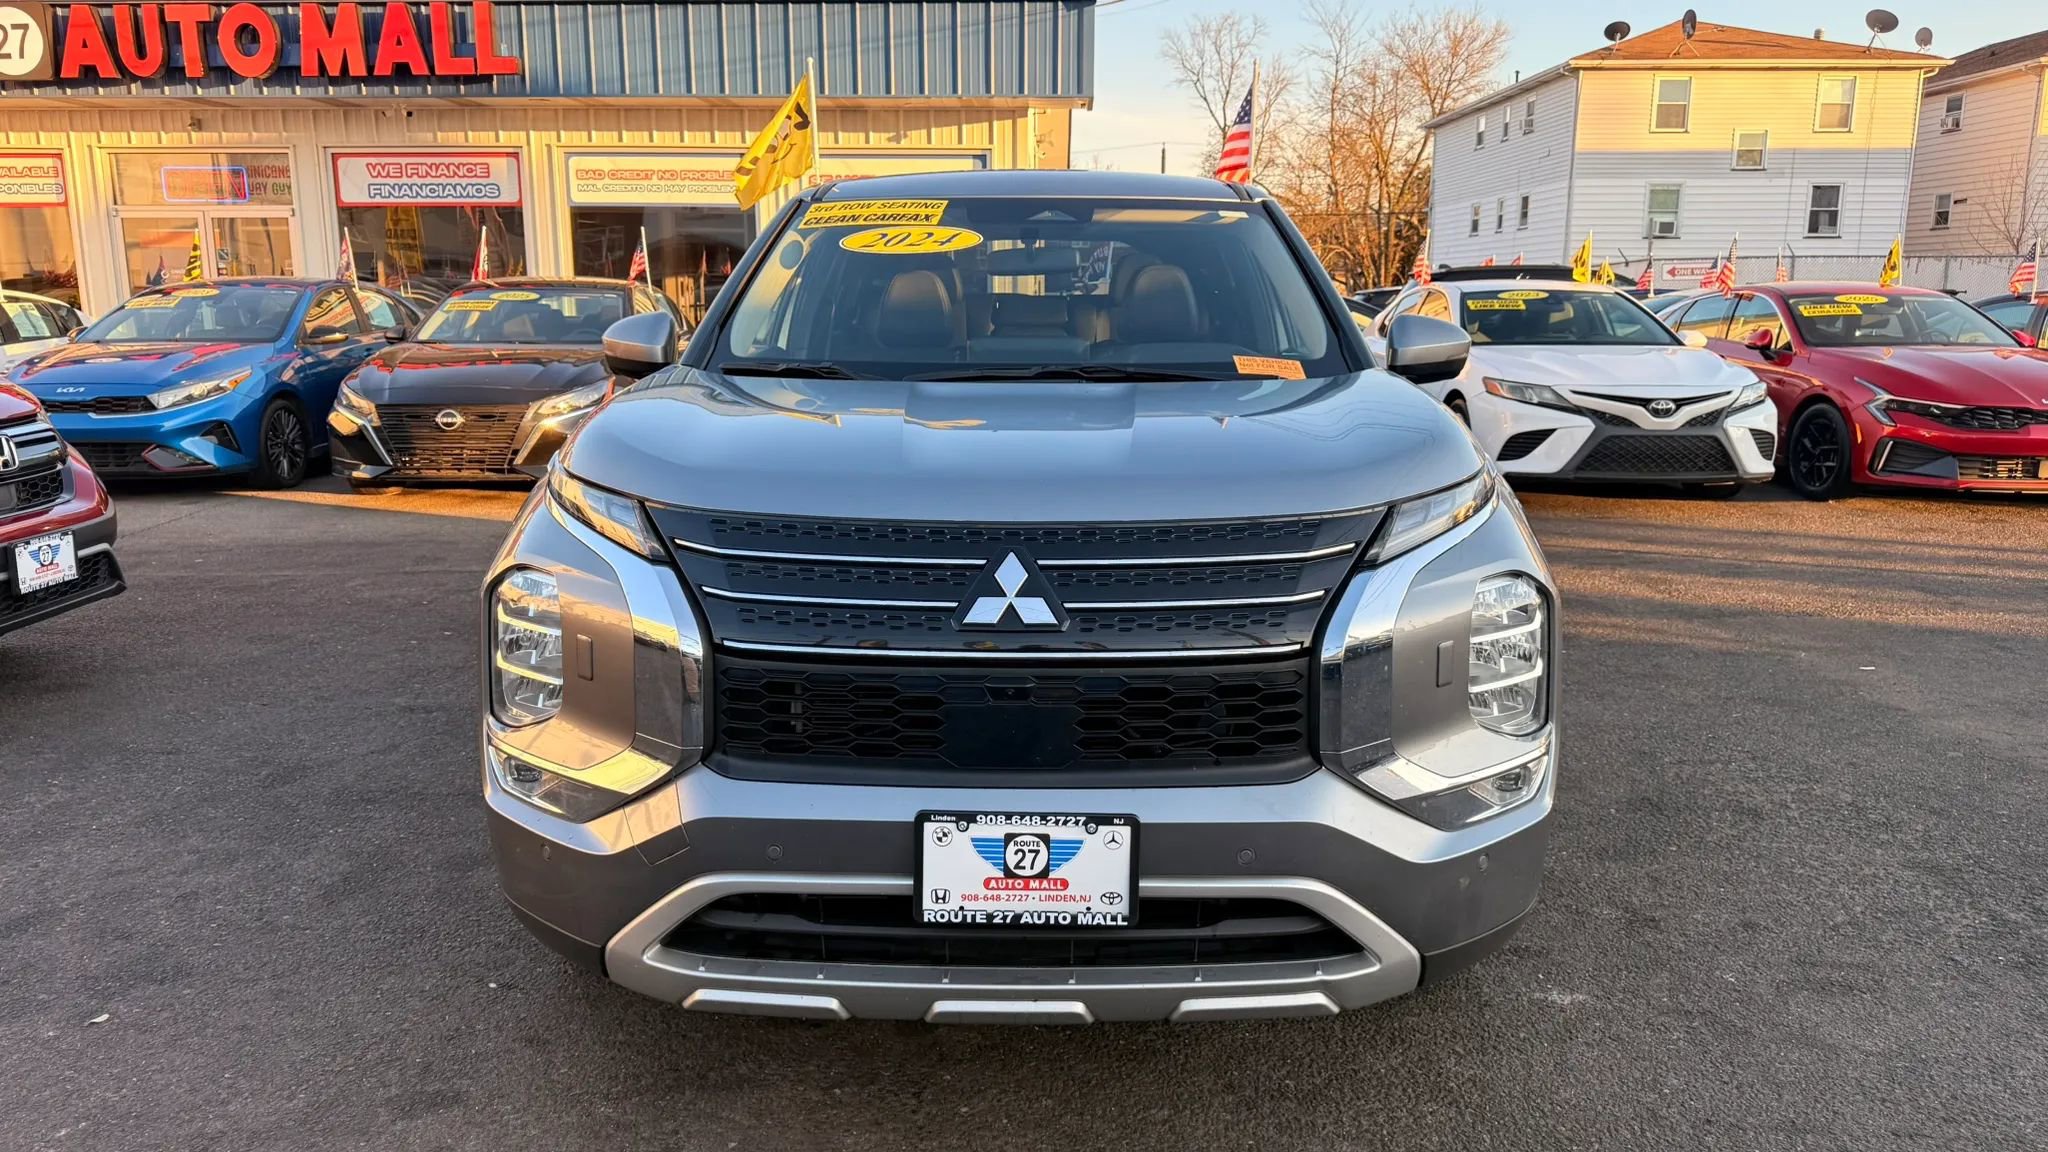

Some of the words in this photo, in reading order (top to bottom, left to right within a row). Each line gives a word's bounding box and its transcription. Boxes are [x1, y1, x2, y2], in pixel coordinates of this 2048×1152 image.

[60, 2, 280, 79] AUTO
[301, 2, 519, 77] MALL
[366, 162, 402, 178] WE
[405, 162, 490, 178] FINANCE
[576, 169, 605, 181] BAD
[608, 169, 655, 181] CREDIT
[657, 170, 678, 181] NO
[680, 170, 736, 182] PROBLE
[368, 183, 500, 199] FINANCIAMOS
[577, 183, 600, 192] MAL
[602, 184, 645, 193] CREDITO
[647, 184, 661, 193] NO
[664, 184, 687, 193] HAY
[688, 184, 737, 193] PROBLEM
[810, 204, 836, 214] 3rd
[838, 202, 877, 211] ROW
[877, 201, 944, 210] SEATING
[802, 213, 862, 226] CLEAN
[863, 213, 936, 223] CARFAX
[860, 231, 963, 248] 2024
[1674, 268, 1692, 276] ONE
[976, 814, 1087, 828] 908-648-2727
[1013, 840, 1041, 849] ROUTE
[1013, 849, 1041, 871] 27
[989, 878, 1025, 889] AUTO
[1029, 879, 1064, 890] MALL
[960, 893, 1030, 902] 908-648-2727
[1038, 894, 1092, 903] LINDEN,NJ
[923, 909, 987, 923] ROUTE
[992, 911, 1014, 924] 27
[1019, 910, 1071, 925] AUTO
[1077, 911, 1128, 926] MALL
